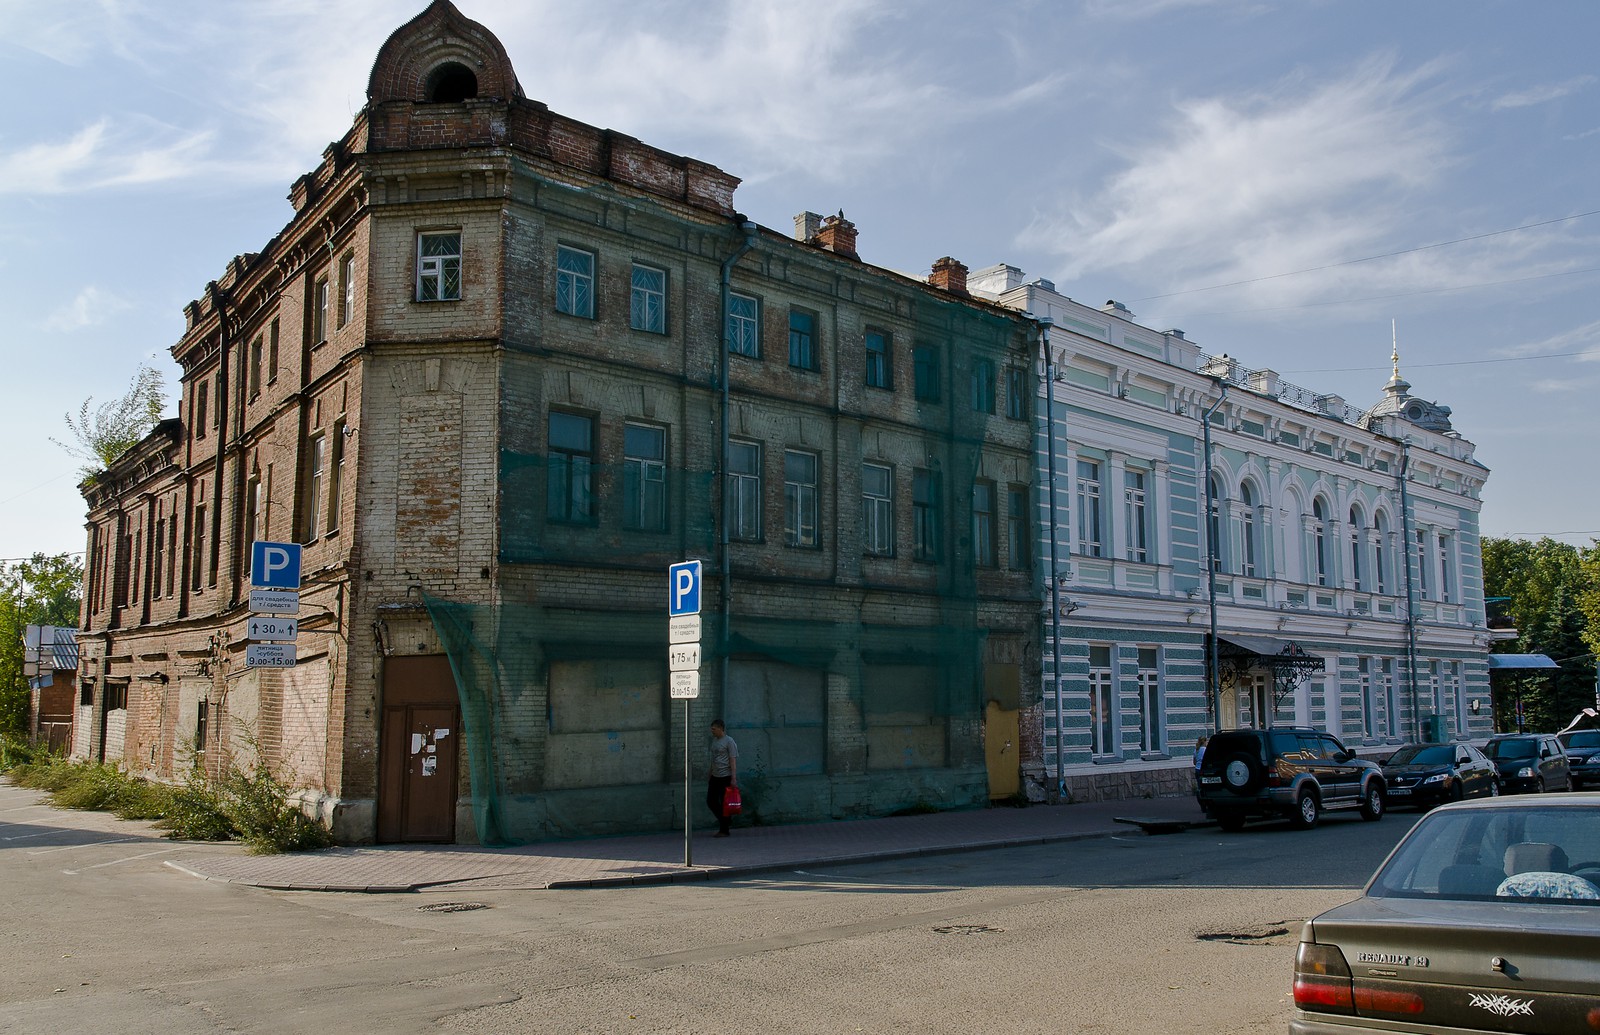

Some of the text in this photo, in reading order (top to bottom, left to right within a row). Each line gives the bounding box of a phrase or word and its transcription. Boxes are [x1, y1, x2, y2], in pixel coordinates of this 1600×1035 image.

[263, 547, 290, 582] P
[676, 568, 694, 610] P
[262, 624, 276, 634] 30
[249, 657, 295, 666] 9.00-15.00
[677, 653, 686, 663] 75
[672, 686, 697, 696] 9.00-15.00
[1356, 952, 1428, 967] RENAULT 19
